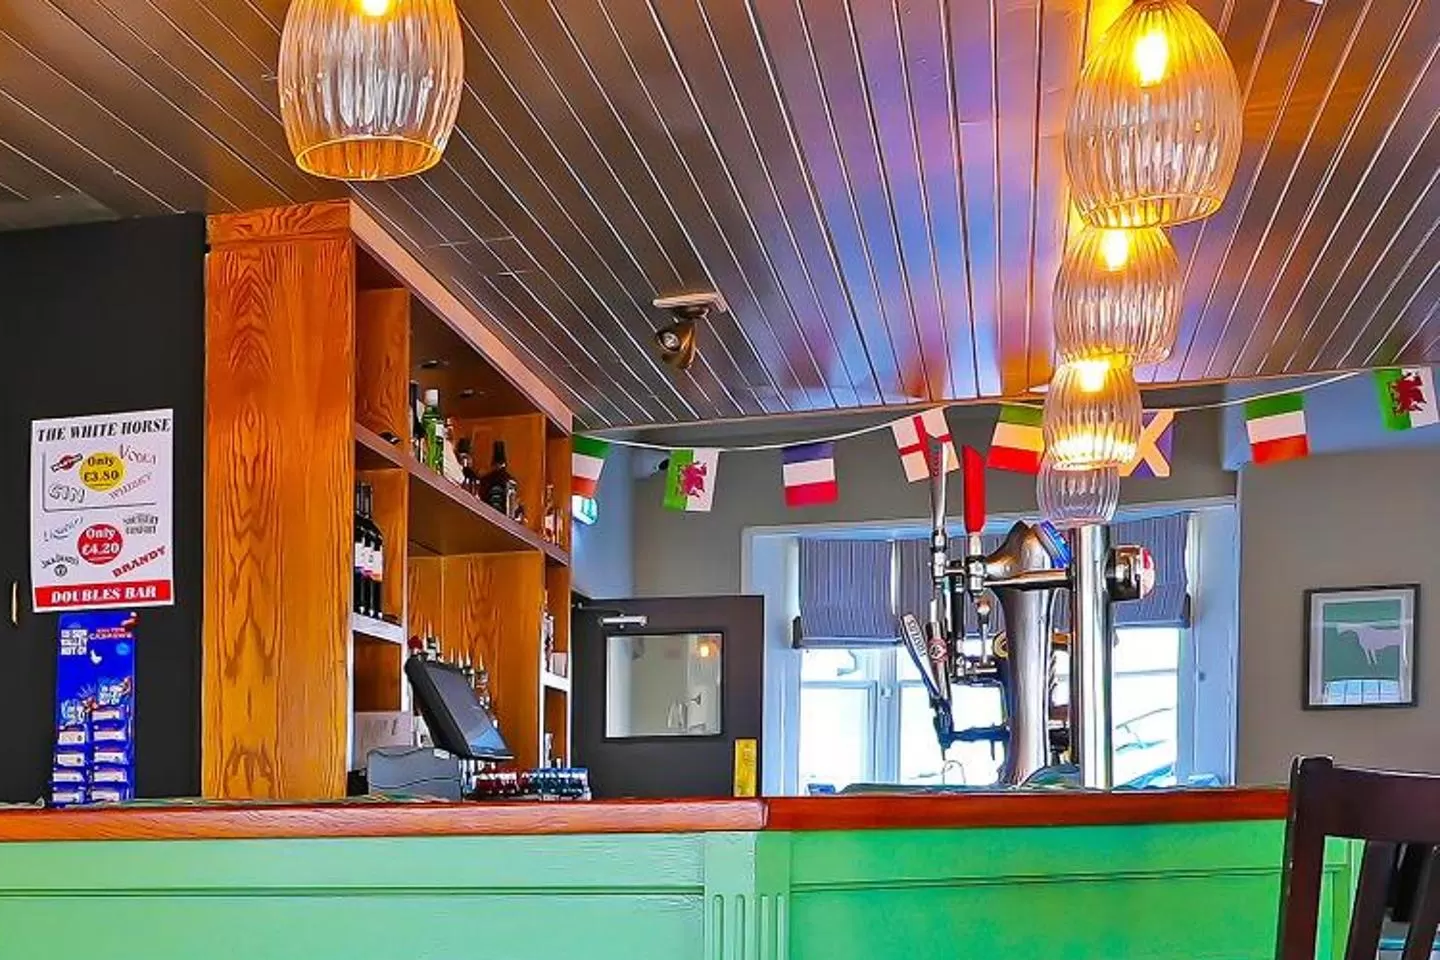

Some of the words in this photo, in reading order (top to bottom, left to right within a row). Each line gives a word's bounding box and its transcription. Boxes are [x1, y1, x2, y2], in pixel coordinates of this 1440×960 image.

[38, 427, 66, 442] THE
[70, 422, 118, 438] WHITE
[121, 418, 171, 435] HORSE
[87, 455, 114, 467] Only
[86, 528, 115, 539] Only
[112, 545, 166, 578] BRANDY
[51, 588, 121, 603] DOUBLES
[125, 586, 157, 600] BAR
